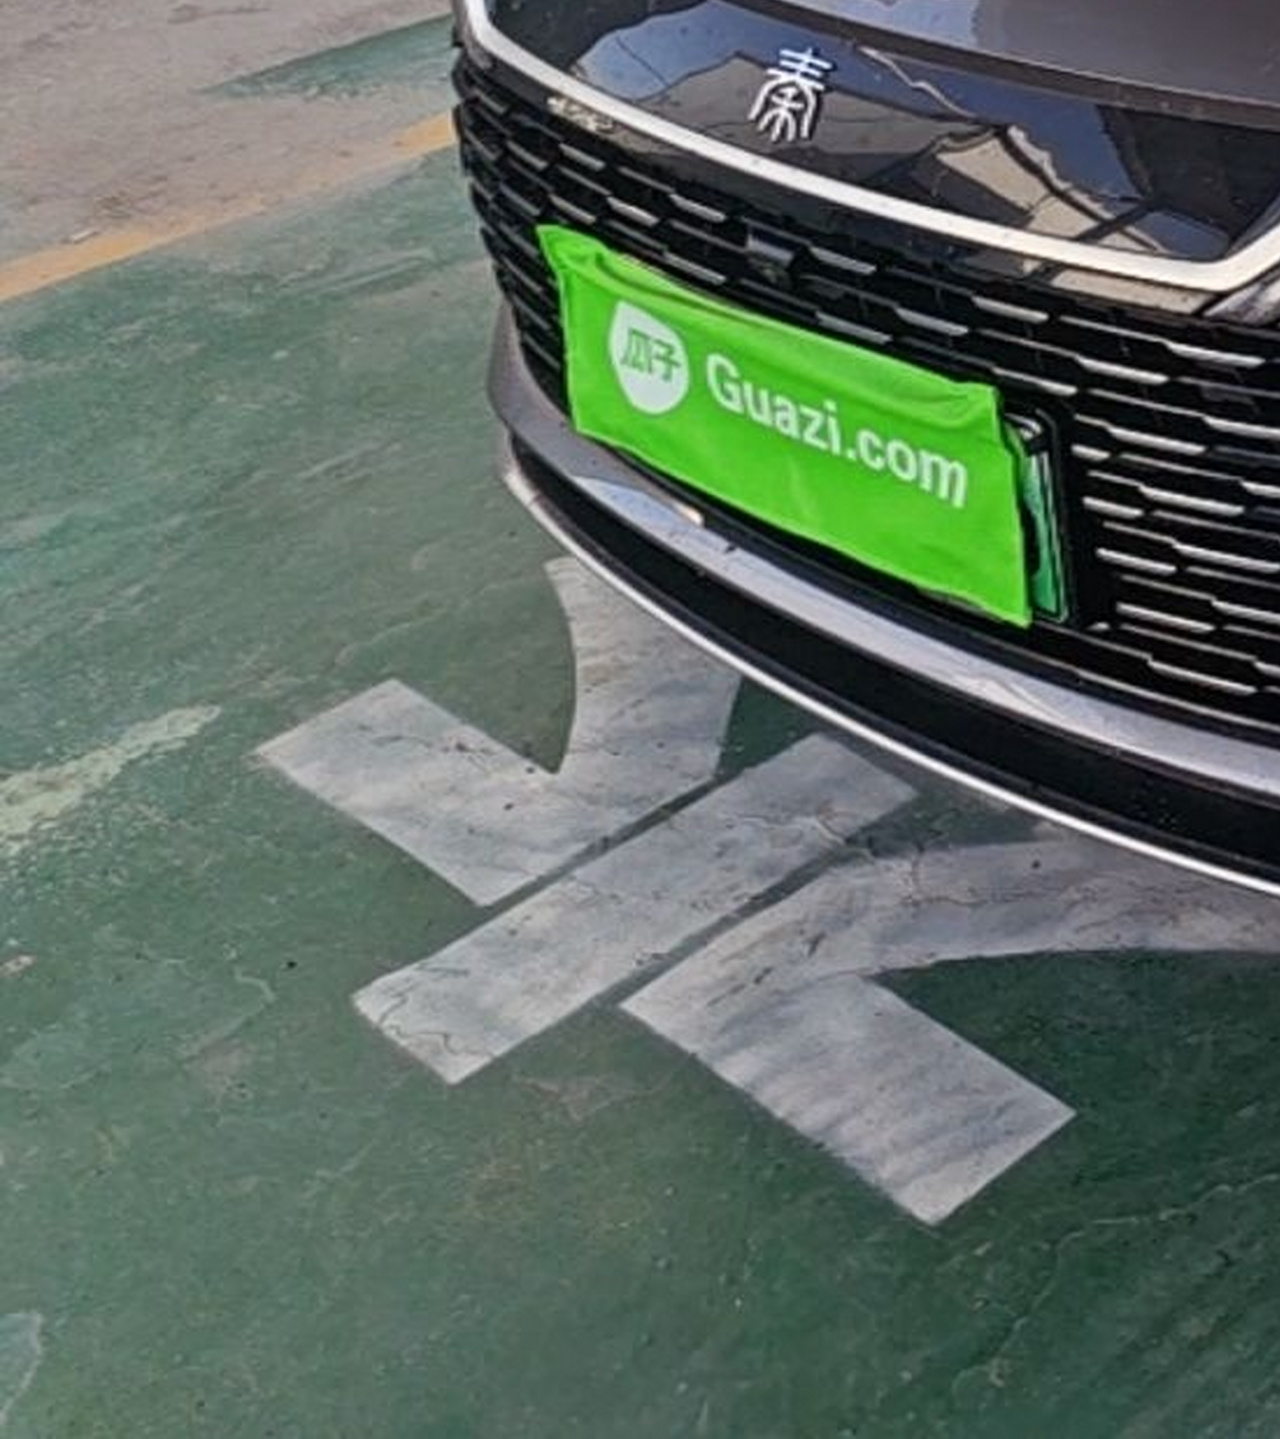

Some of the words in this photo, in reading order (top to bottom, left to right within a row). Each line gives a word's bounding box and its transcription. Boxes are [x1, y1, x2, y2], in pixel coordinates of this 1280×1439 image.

[747, 47, 834, 142] 秦
[620, 326, 682, 383] 瓜子
[705, 353, 968, 509] Guazi.com
